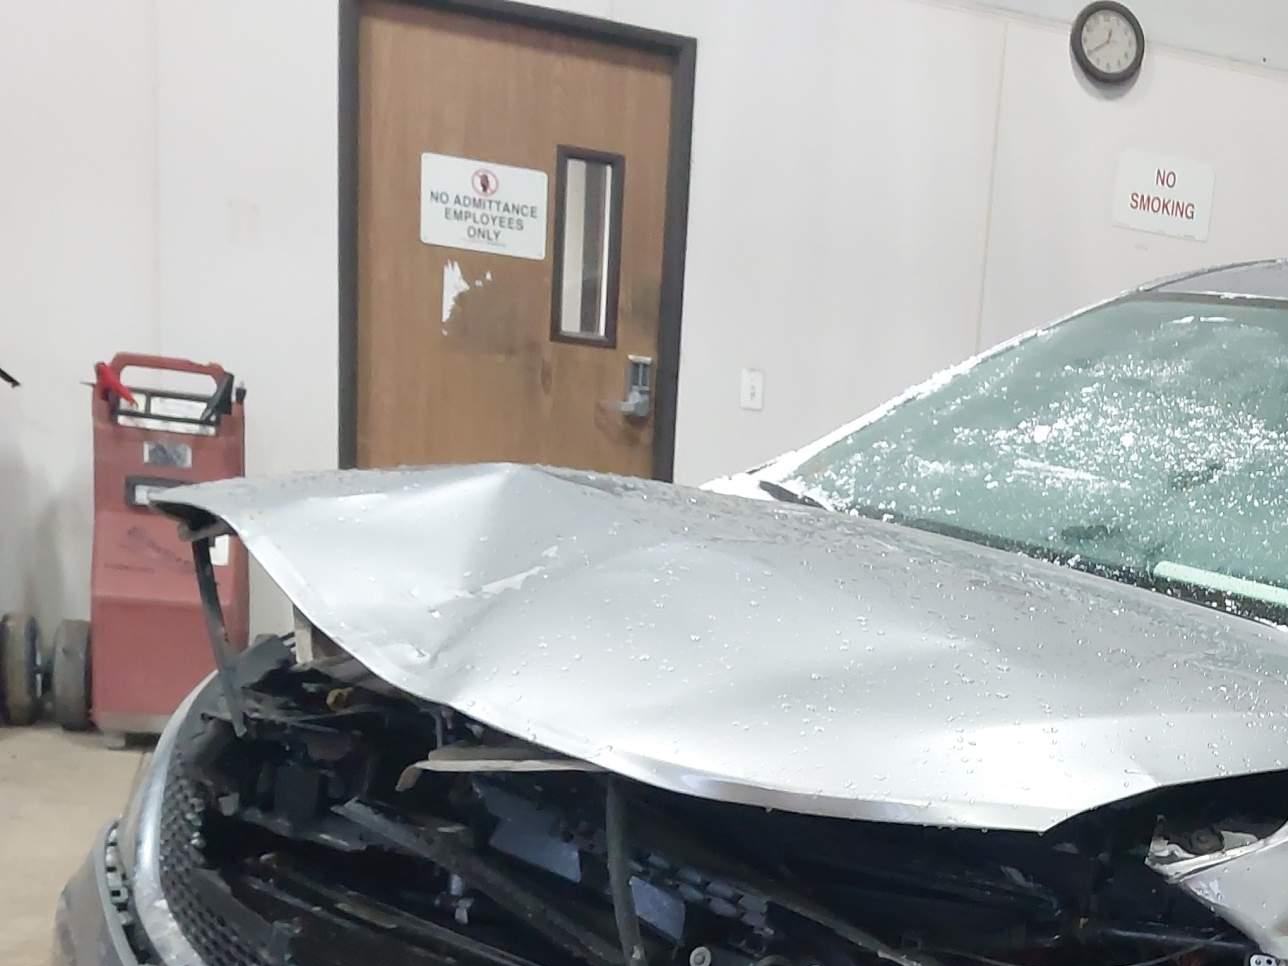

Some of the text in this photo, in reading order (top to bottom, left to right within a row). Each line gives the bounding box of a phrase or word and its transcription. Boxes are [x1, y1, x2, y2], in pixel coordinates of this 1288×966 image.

[1155, 168, 1176, 188] NO
[430, 191, 538, 219] NO ADMITTANCE
[1129, 192, 1195, 220] SMOKING
[444, 207, 525, 231] EMPLOYEES
[467, 226, 501, 241] ONLY
